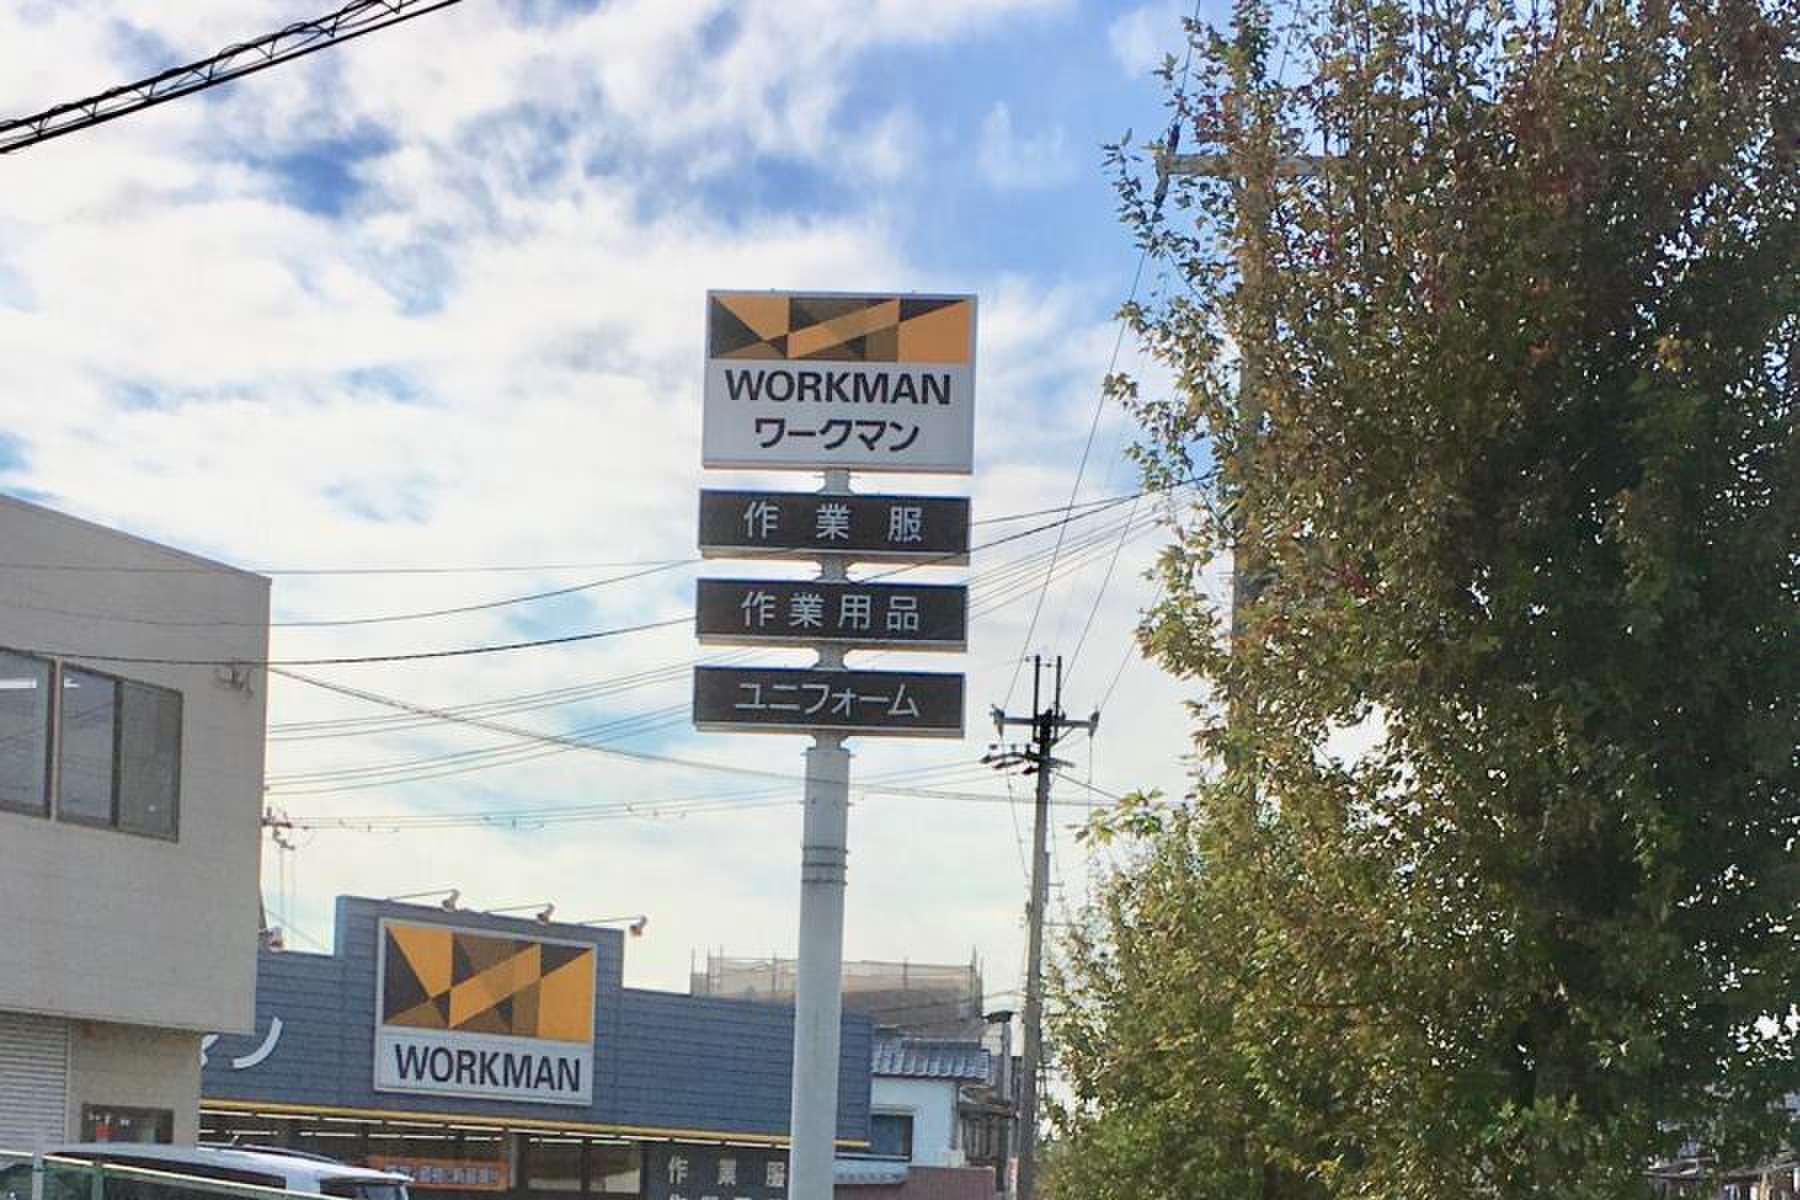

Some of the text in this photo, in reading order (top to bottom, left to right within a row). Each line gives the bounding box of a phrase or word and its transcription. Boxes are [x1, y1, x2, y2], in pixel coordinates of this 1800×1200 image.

[724, 369, 952, 405] WORKMAN
[755, 417, 920, 452] ワークマン
[743, 500, 923, 543] 作業服
[740, 591, 921, 632] 作業用品
[735, 683, 921, 718] ユニフォーム
[395, 1044, 580, 1092] WORKMAN
